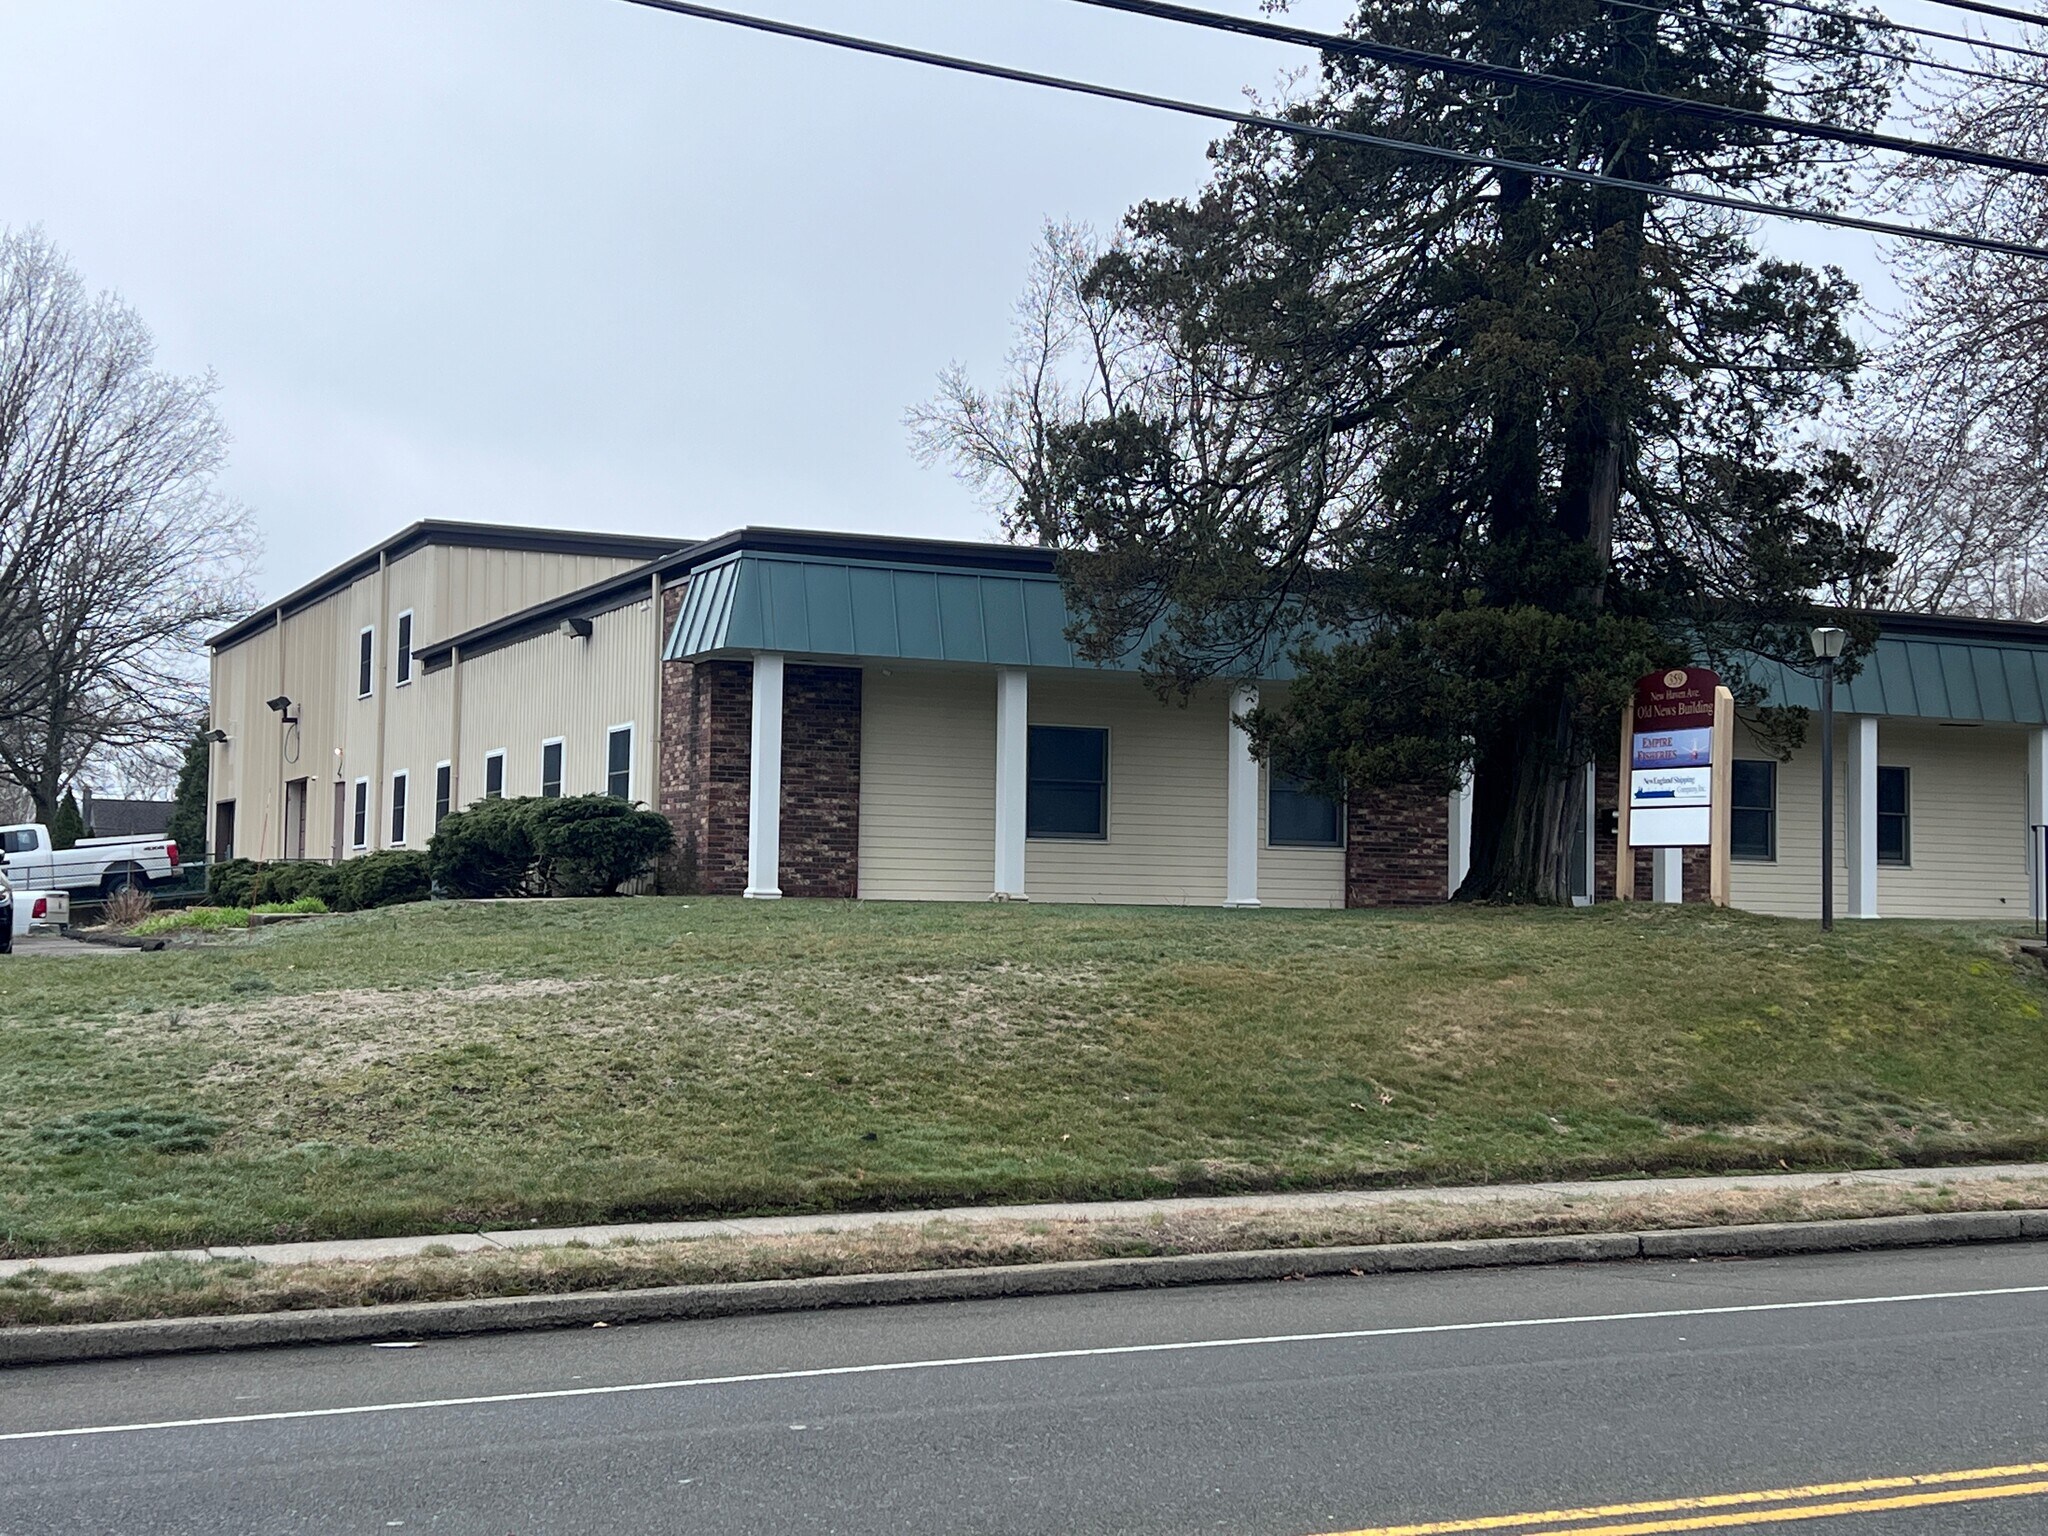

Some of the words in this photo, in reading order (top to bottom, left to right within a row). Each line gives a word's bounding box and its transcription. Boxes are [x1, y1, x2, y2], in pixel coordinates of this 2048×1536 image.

[1668, 673, 1684, 686] 359
[1650, 691, 1665, 702] New
[1666, 689, 1686, 700] Haven
[1637, 705, 1652, 719] Old
[1654, 704, 1676, 718] News
[1678, 700, 1714, 716] Building
[1642, 737, 1673, 749] EMPIRE
[1637, 750, 1677, 761] FISHERIES
[1653, 776, 1673, 786] England
